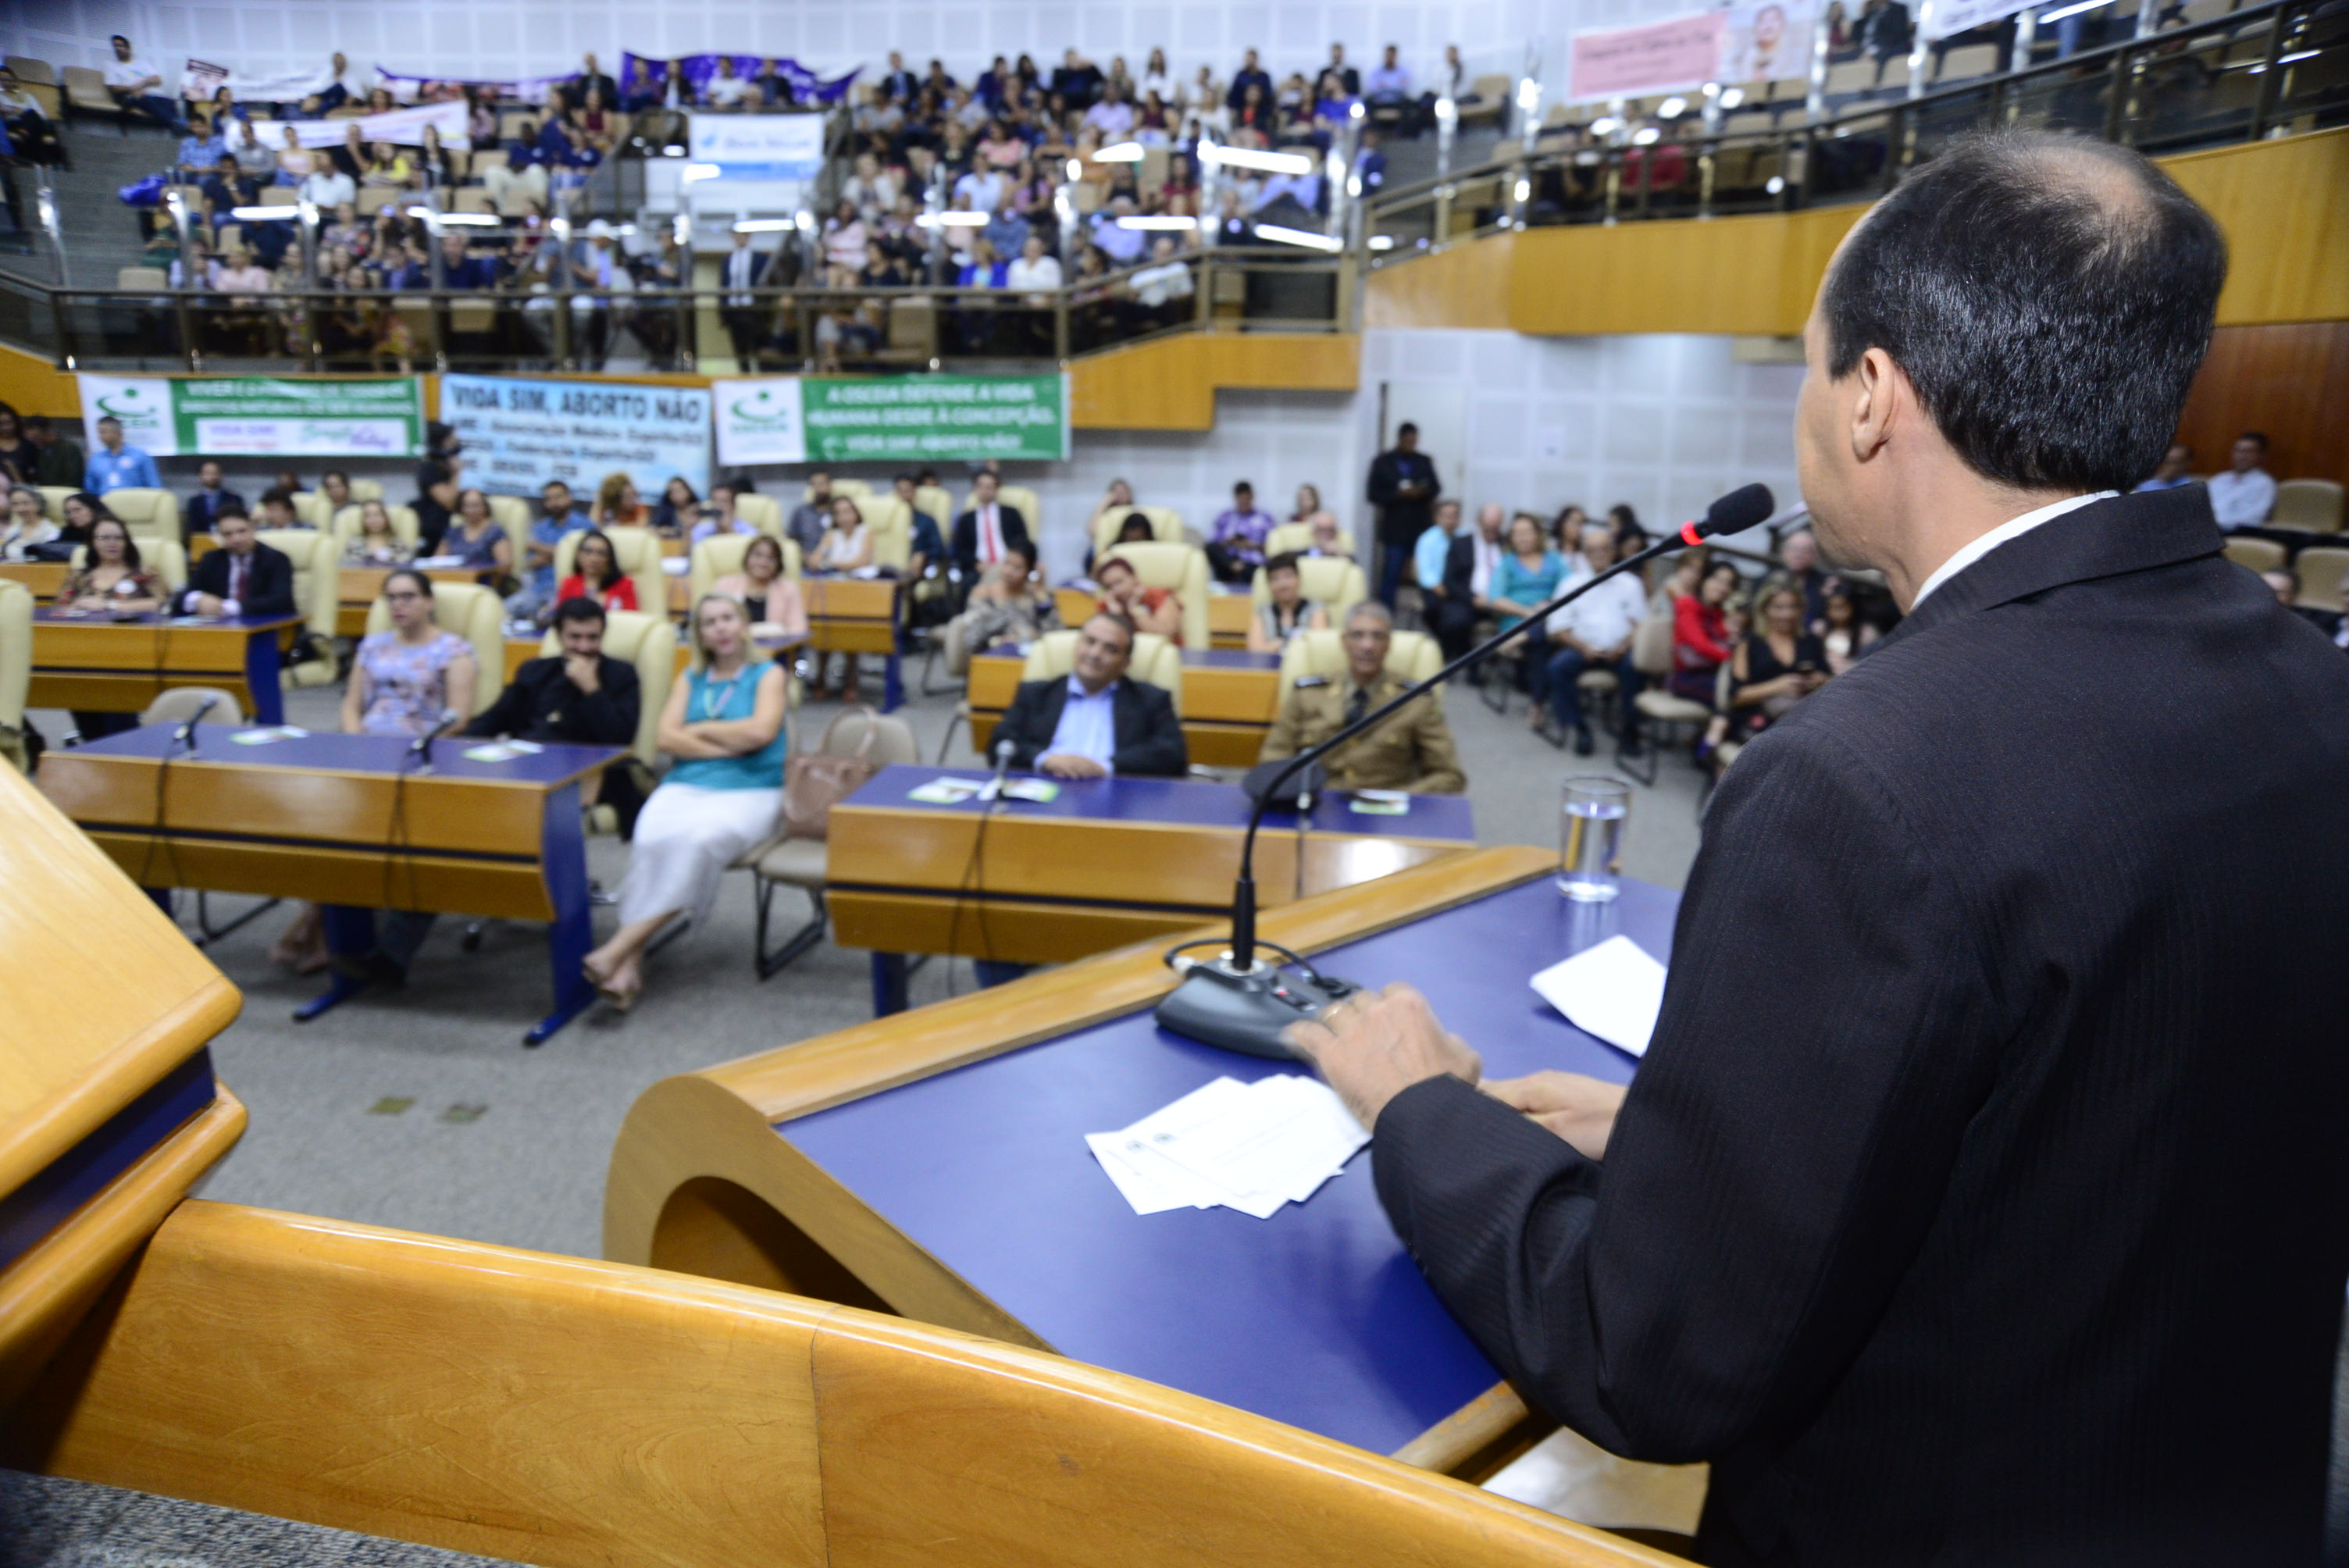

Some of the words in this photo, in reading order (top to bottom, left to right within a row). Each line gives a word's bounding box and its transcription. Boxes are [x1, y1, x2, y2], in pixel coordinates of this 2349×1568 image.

[451, 383, 501, 409] VIDA
[560, 392, 647, 420] ABORTO
[654, 392, 701, 422] NÃO
